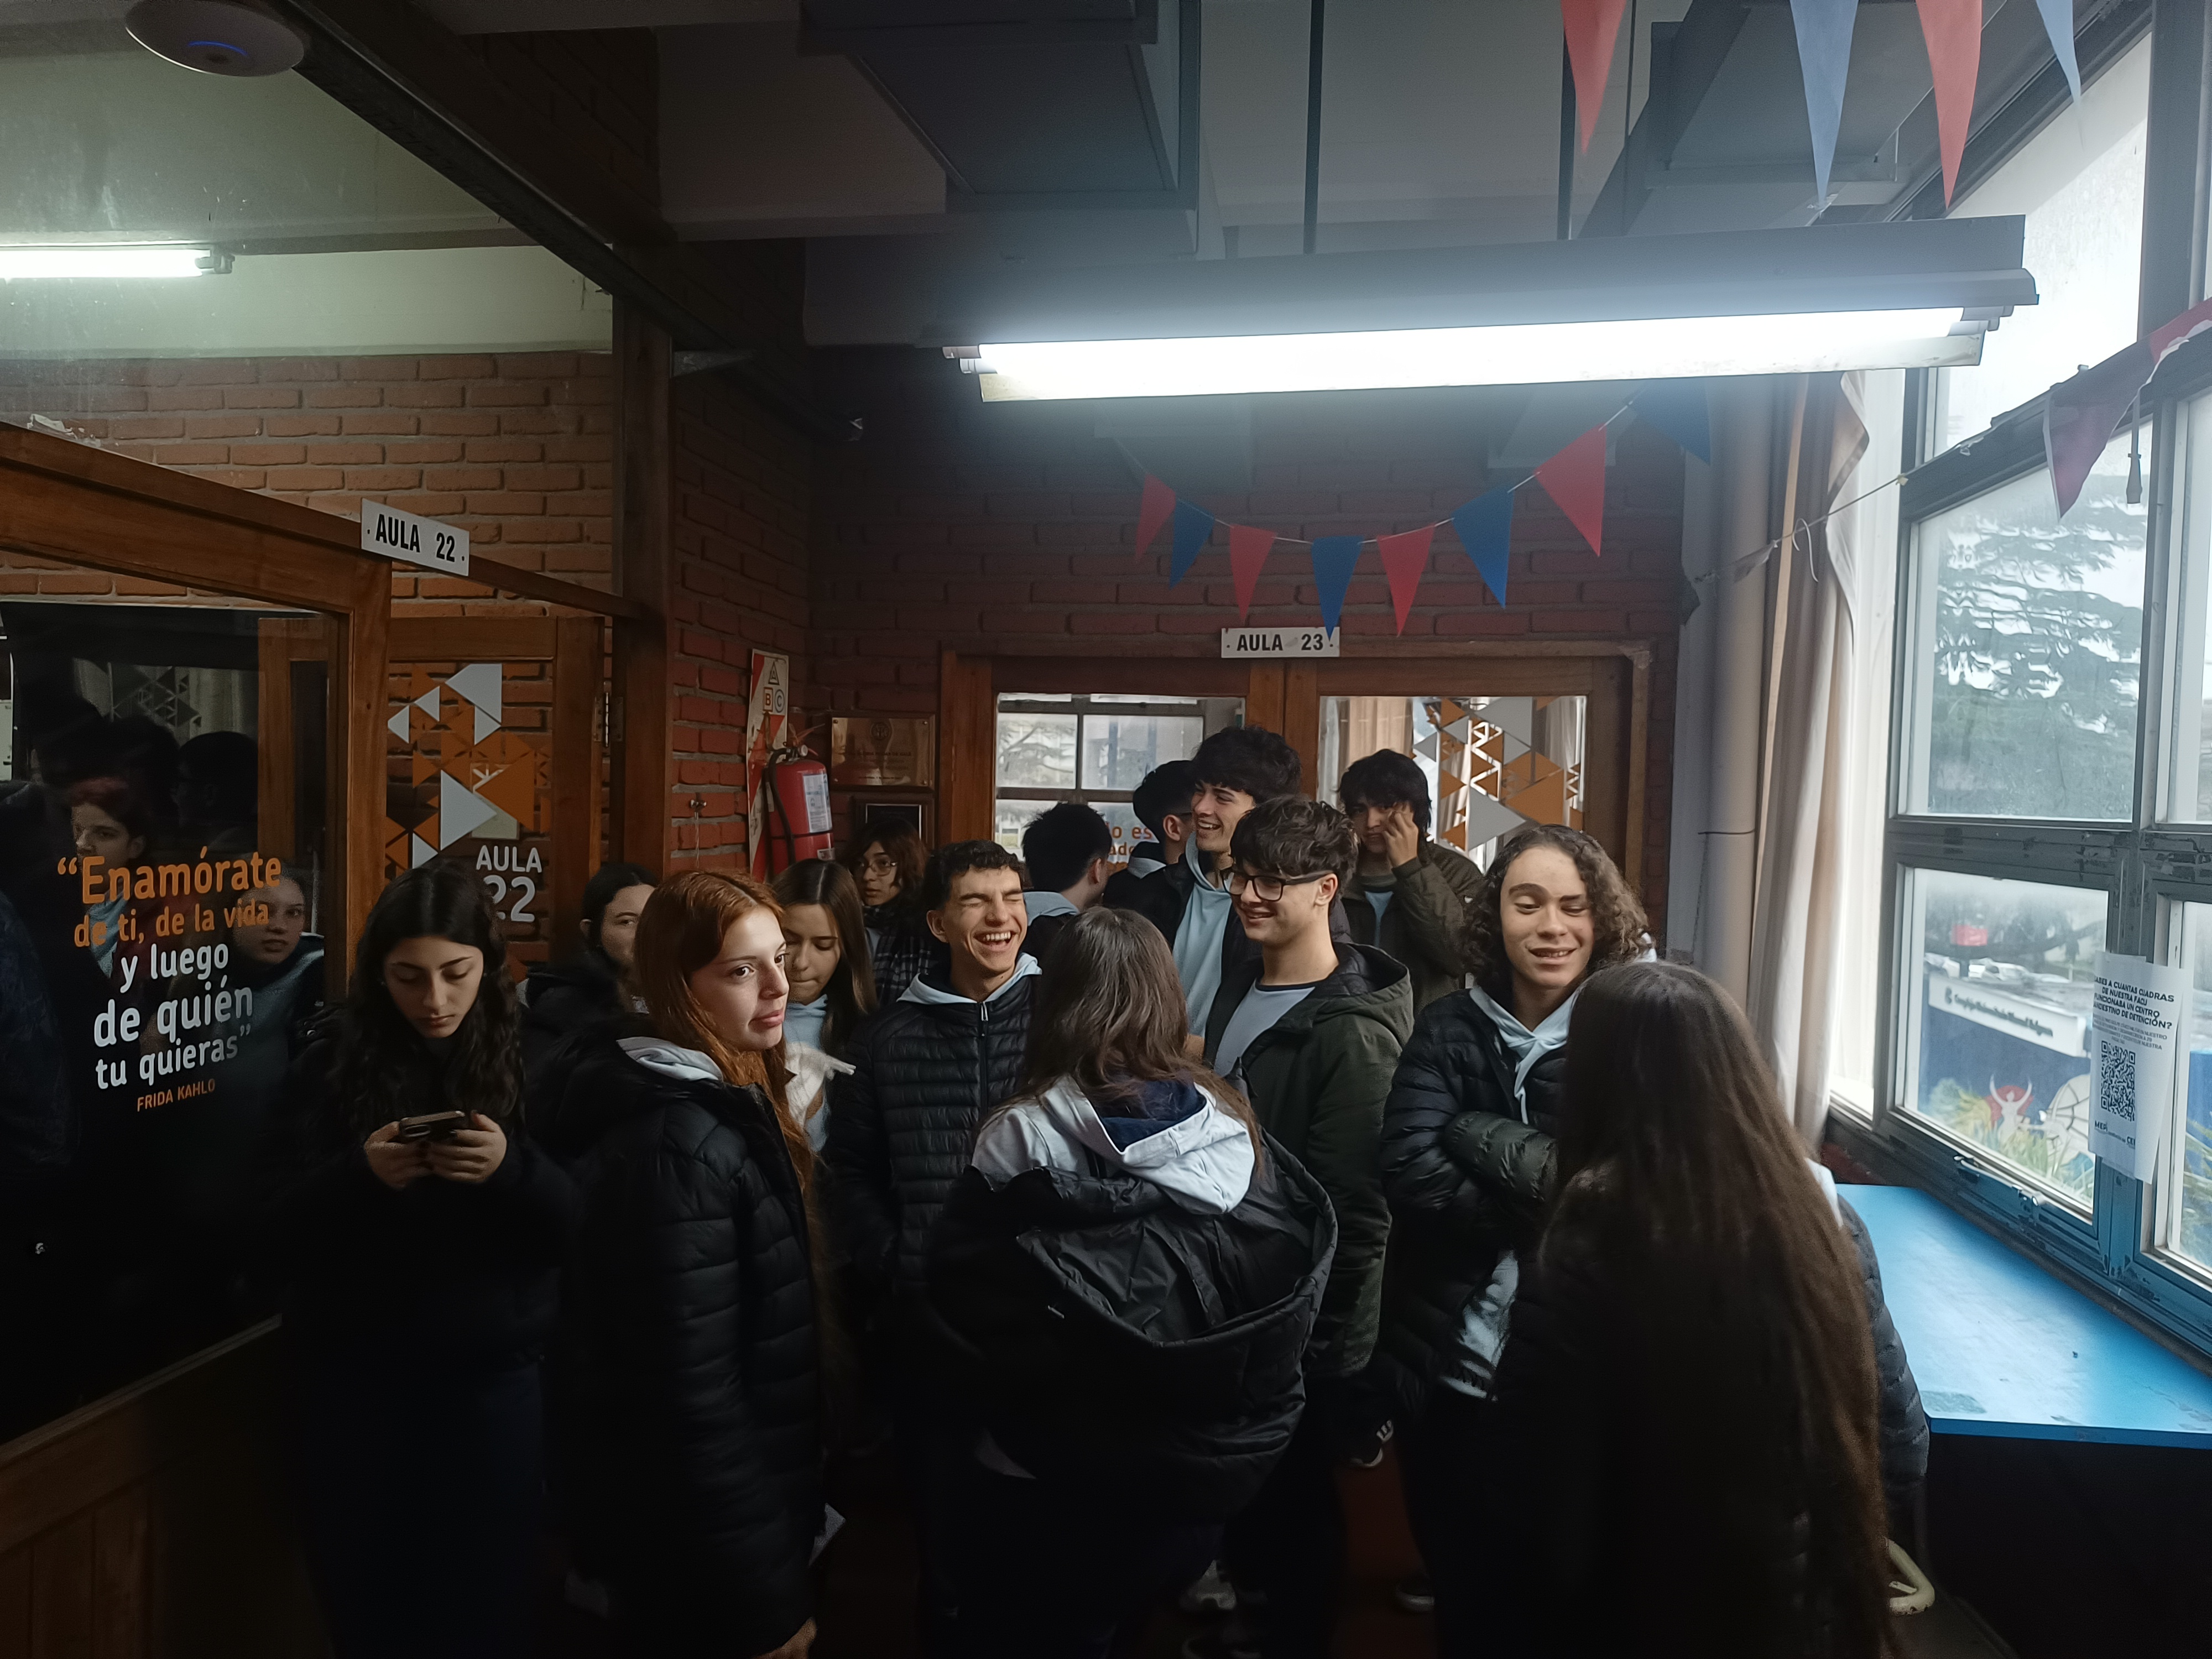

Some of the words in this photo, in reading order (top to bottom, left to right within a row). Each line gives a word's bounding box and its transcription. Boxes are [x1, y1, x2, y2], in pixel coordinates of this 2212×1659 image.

[375, 513, 420, 553] AULA
[436, 532, 455, 563] 22
[1237, 634, 1283, 651] AULA
[1301, 634, 1323, 651] 23
[765, 693, 771, 706] B
[776, 695, 783, 707] C
[1131, 826, 1153, 839] es
[58, 846, 281, 905] “Enamórate
[476, 844, 542, 878] AULA
[483, 874, 536, 922] 22
[74, 914, 108, 948] de
[117, 908, 145, 944] ti,
[155, 905, 185, 937] de
[194, 902, 215, 932] la
[223, 898, 270, 928] vida
[119, 954, 139, 994] y
[150, 942, 229, 980] luego
[2110, 988, 2133, 1003] NUESTRA
[2114, 981, 2137, 994] CUANTAS
[2138, 988, 2174, 1002] CUADRAS
[93, 998, 141, 1047] de
[156, 974, 253, 1044] quién
[2127, 1003, 2134, 1011] UN
[2135, 1005, 2161, 1018] CENTRO
[95, 1058, 128, 1089] tu
[139, 1022, 252, 1087] quieras”
[137, 1088, 173, 1113] FRIDA
[177, 1078, 216, 1101] KAHLO
